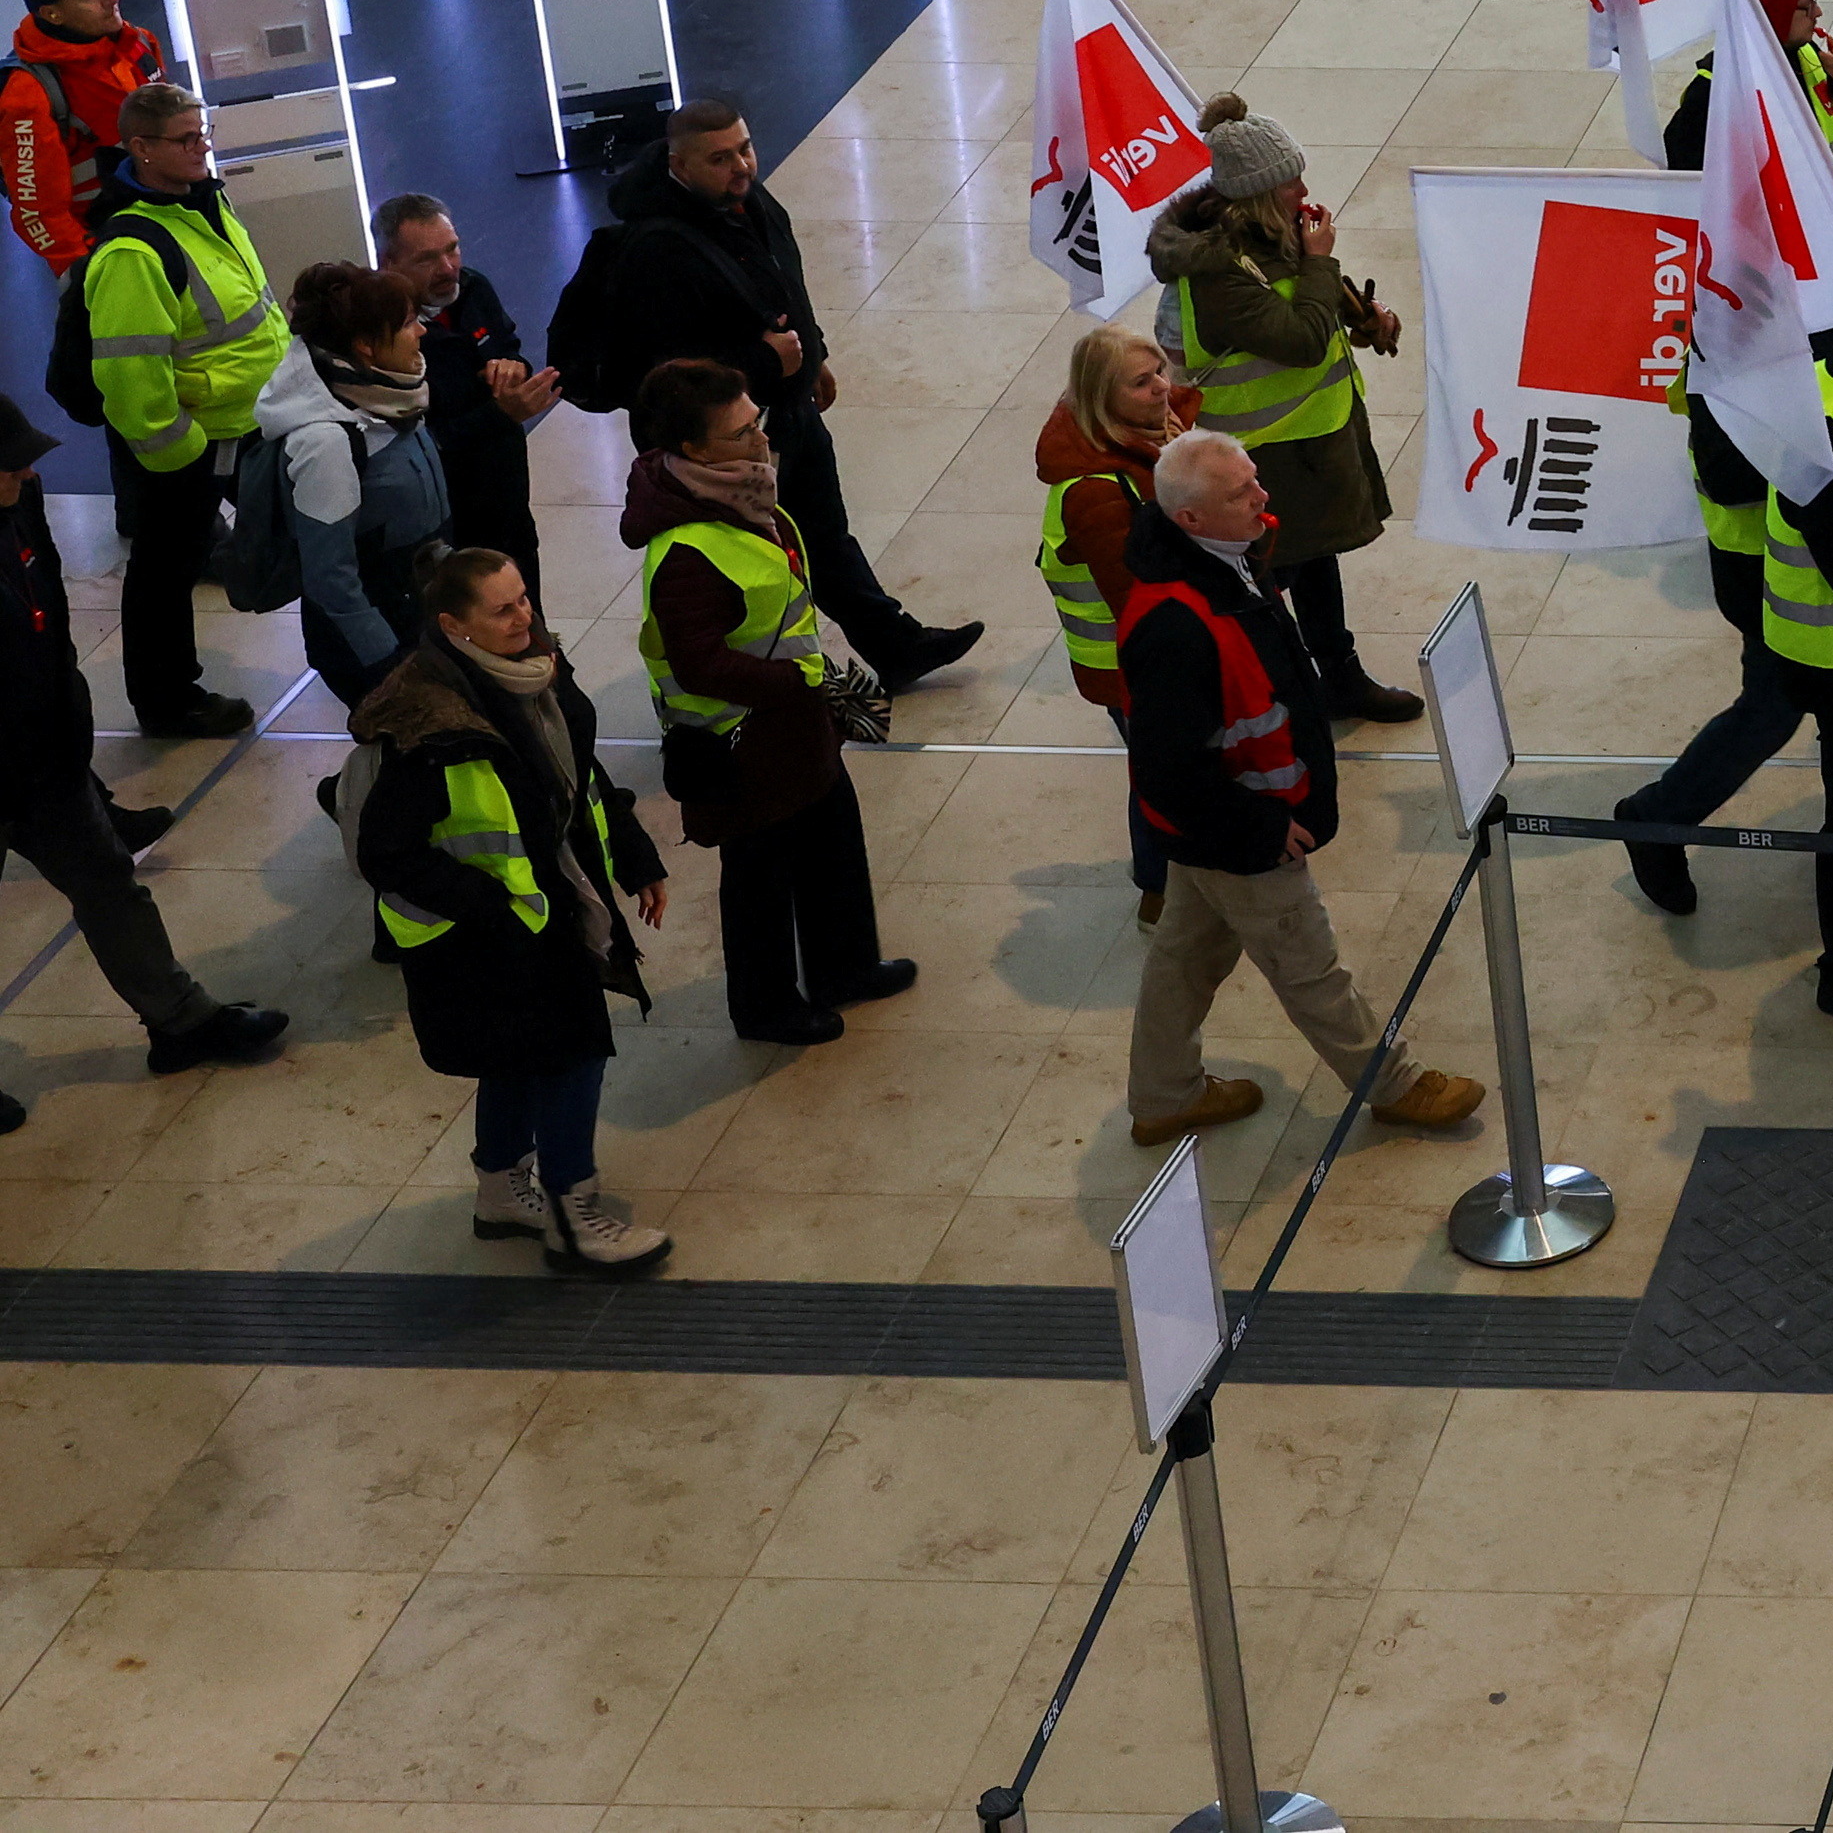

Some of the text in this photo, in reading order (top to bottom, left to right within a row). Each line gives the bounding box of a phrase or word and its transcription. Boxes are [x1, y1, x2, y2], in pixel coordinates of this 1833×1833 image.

[15, 119, 37, 200] HANSEN
[1516, 818, 1550, 832] BER
[1739, 832, 1773, 846] BER
[1312, 1159, 1327, 1193] BER
[1231, 1314, 1247, 1351] BER
[1133, 1503, 1149, 1543] BER
[1042, 1698, 1060, 1741] BER
